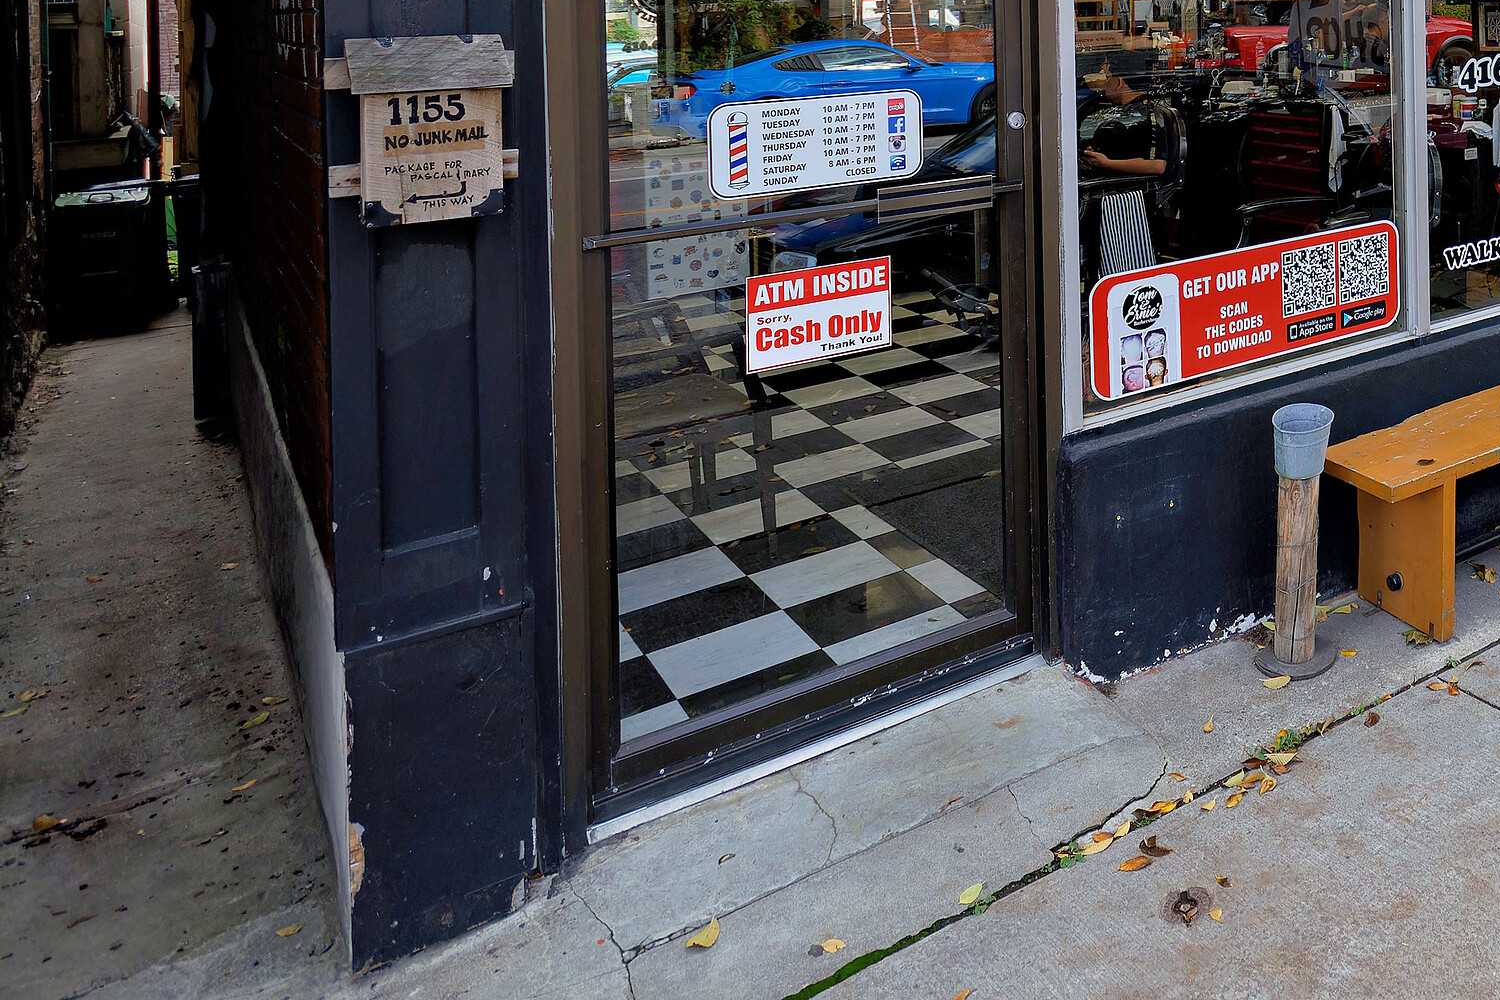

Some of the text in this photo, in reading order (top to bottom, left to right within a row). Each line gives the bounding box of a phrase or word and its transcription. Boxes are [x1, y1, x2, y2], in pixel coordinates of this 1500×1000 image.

[387, 93, 466, 125] 1155
[762, 108, 801, 118] MONDAY
[834, 105, 848, 113] AM
[863, 102, 875, 110] PM
[762, 119, 800, 129] TUESDAY
[823, 116, 832, 124] 10
[834, 115, 848, 123] AM
[863, 112, 875, 120] PM
[384, 126, 489, 150] NO JUNK MAIL
[762, 129, 815, 141] WEDNESDAY
[823, 127, 832, 135] 10
[834, 126, 848, 134] AM
[855, 124, 860, 132] 7
[863, 123, 875, 131] PM
[763, 141, 807, 152] THURSDAY
[823, 138, 832, 146] 10
[834, 137, 848, 145] AM
[856, 135, 861, 143] 7
[863, 134, 876, 142] PM
[763, 153, 793, 164] FRIDAY
[823, 149, 833, 157] 10
[835, 148, 849, 156] AM
[863, 145, 876, 153] PM
[384, 160, 462, 175] PACKAGE FOR
[410, 171, 453, 182] PASCAL
[463, 167, 491, 179] MARY
[763, 163, 807, 175] SATURDAY
[828, 160, 833, 168] 8
[835, 158, 849, 167] AM
[856, 157, 861, 165] 6
[863, 156, 876, 164] PM
[763, 166, 876, 187] SUNDAY CLOSED
[422, 195, 474, 211] THIS WAY
[754, 265, 886, 307] ATM INSIDE
[1182, 262, 1280, 299] GET OUR APP
[757, 314, 792, 325] Sorry,
[1220, 301, 1249, 320] SCAN
[756, 310, 882, 352] Cash Only
[1205, 314, 1264, 340] THE CODES
[1299, 319, 1319, 328] Available
[1299, 322, 1334, 338] App Store
[820, 333, 883, 352] Thank You!
[1196, 329, 1272, 360] TO DOWNLOAD
